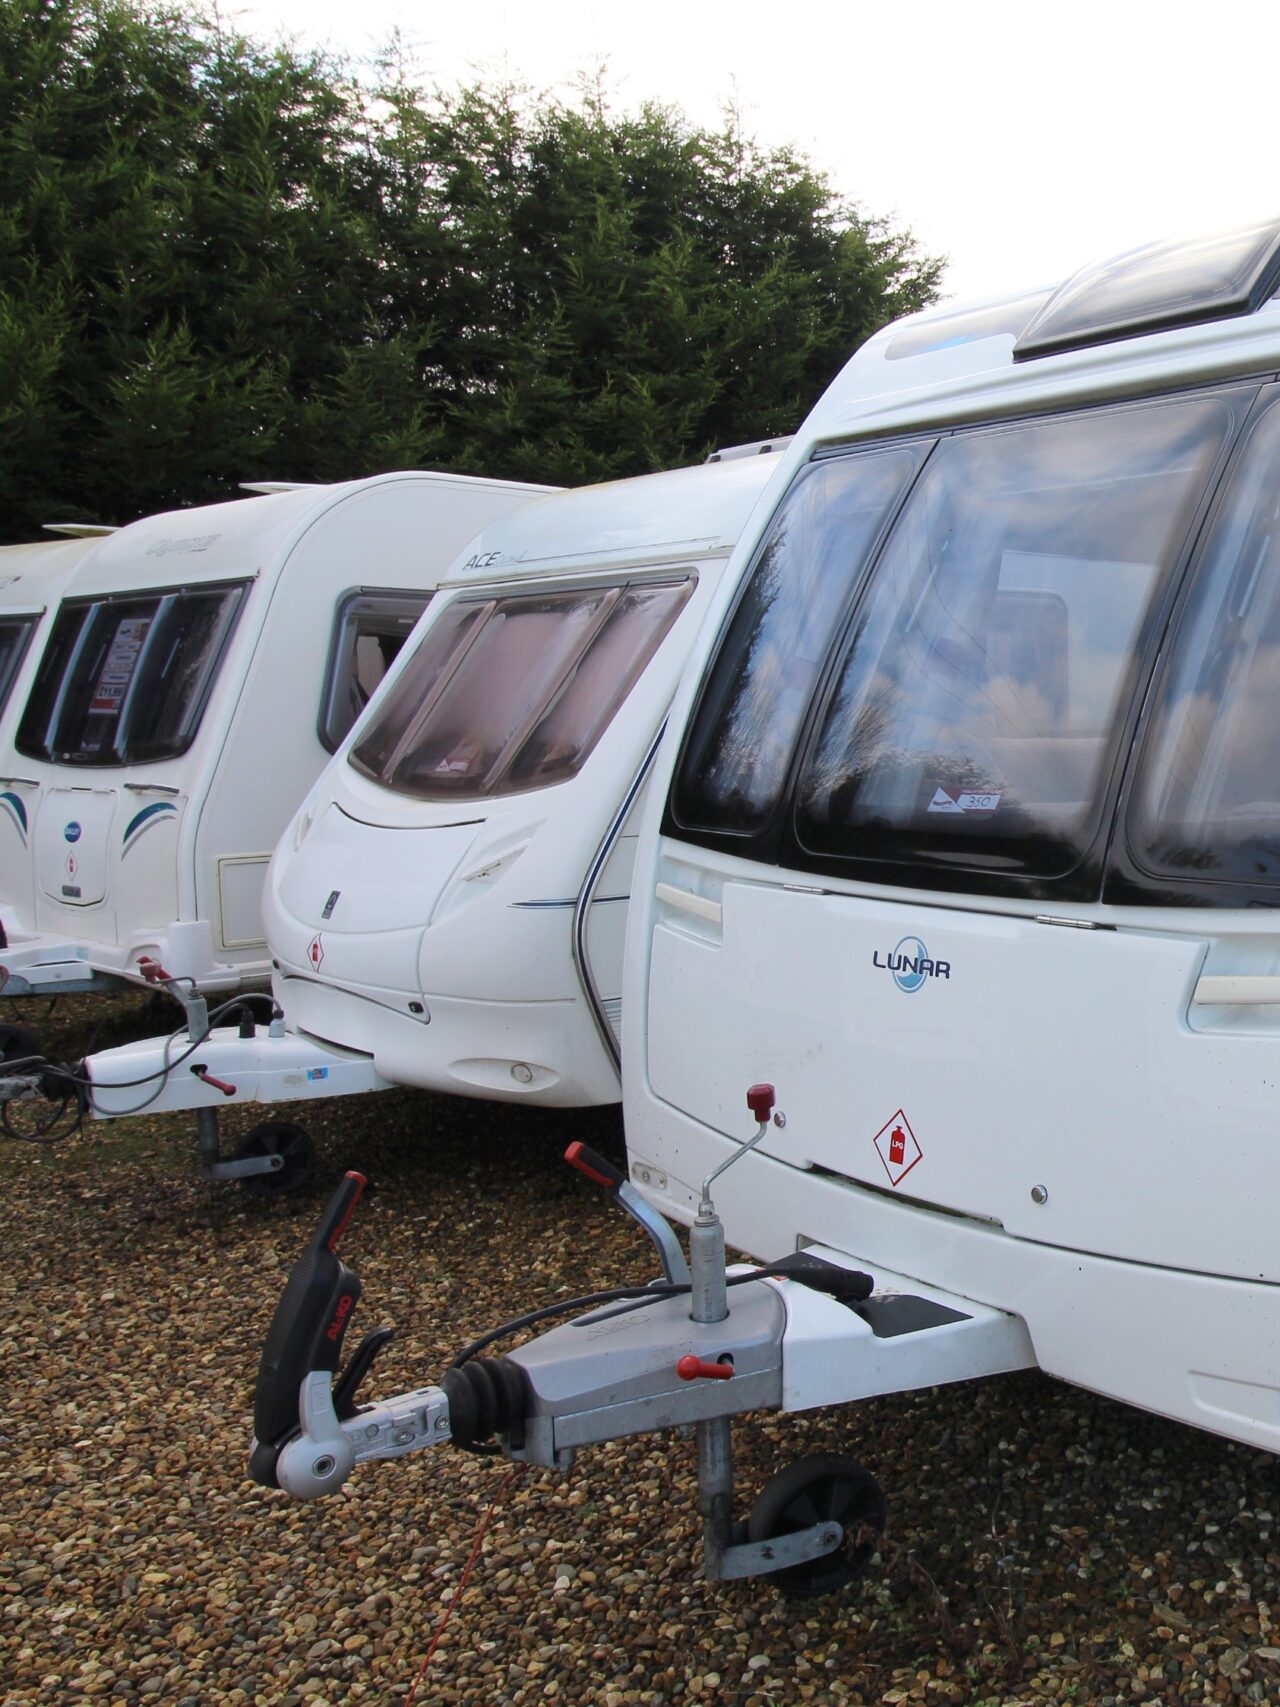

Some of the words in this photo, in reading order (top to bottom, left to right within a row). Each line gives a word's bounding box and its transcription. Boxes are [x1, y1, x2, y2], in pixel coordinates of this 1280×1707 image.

[462, 551, 502, 571] ACE
[966, 795, 992, 808] 350
[872, 950, 951, 979] LUNAR
[892, 1140, 904, 1150] LPG
